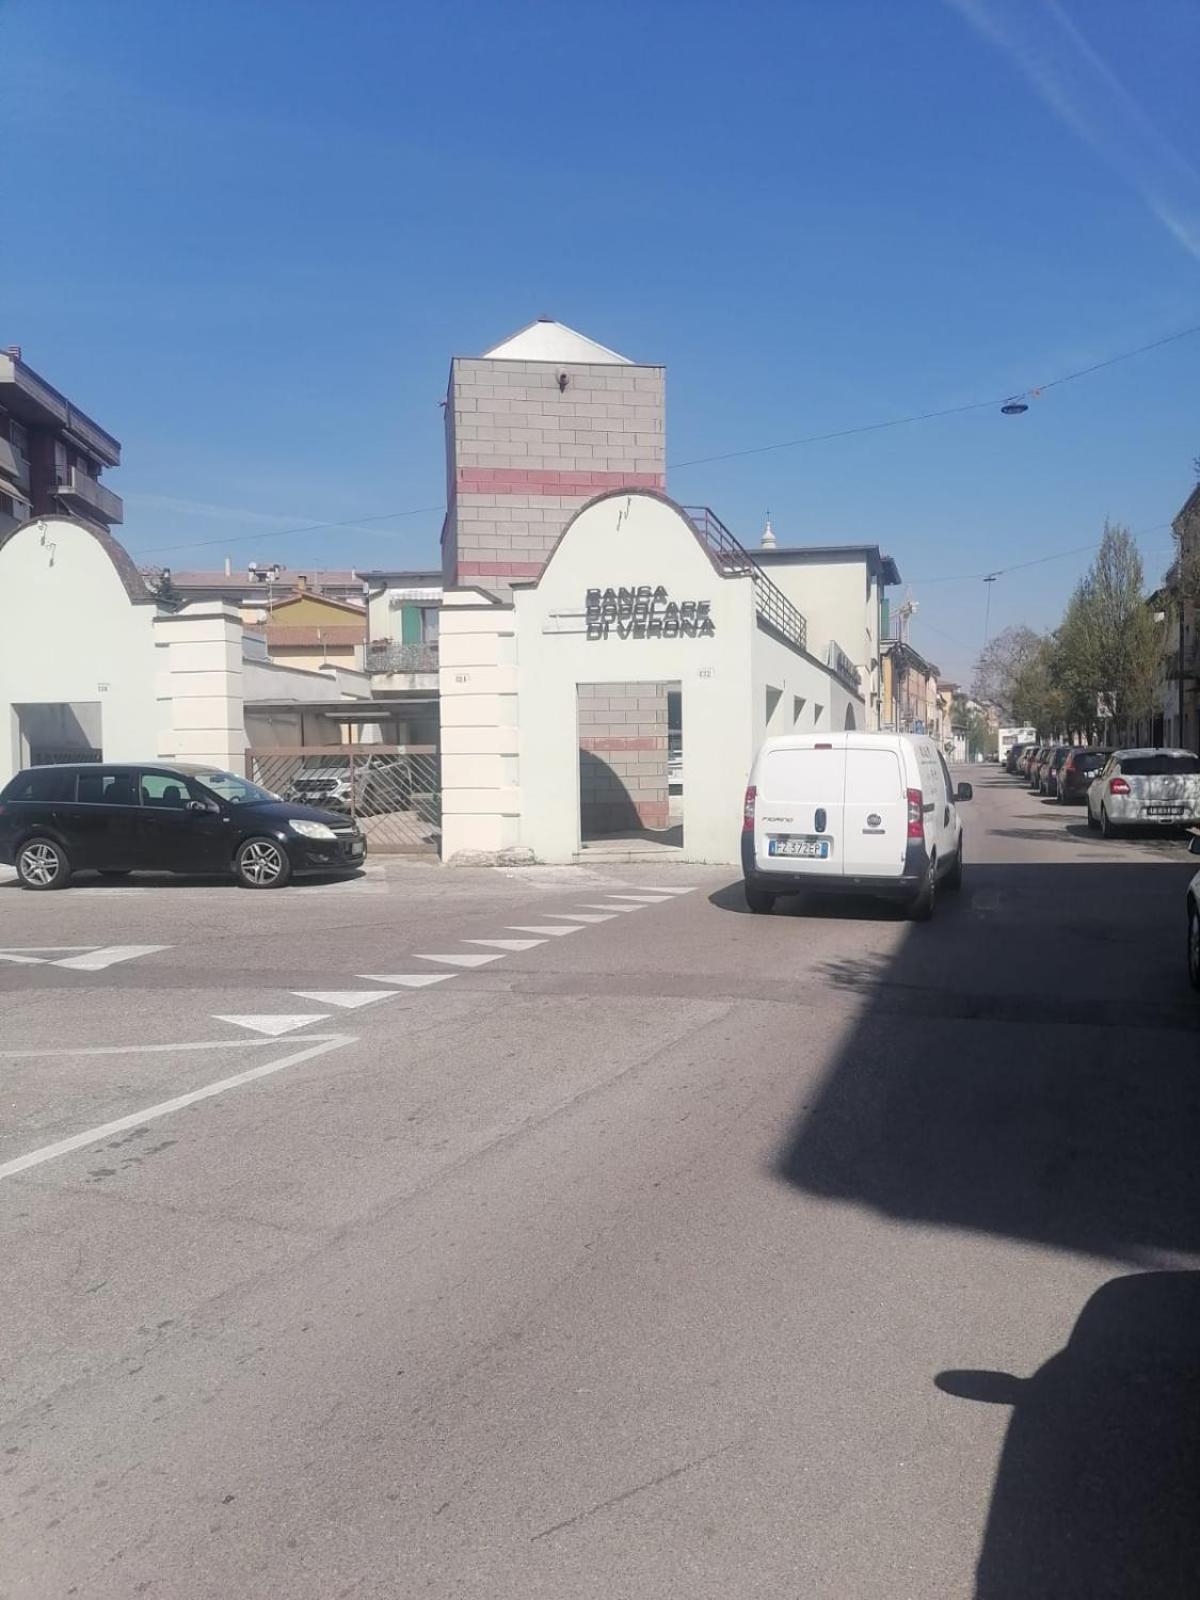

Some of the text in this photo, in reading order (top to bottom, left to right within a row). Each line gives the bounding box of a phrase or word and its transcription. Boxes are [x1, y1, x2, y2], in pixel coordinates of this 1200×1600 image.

[586, 585, 668, 602] BANCA
[586, 600, 711, 619] POPOLARE
[586, 618, 716, 638] DI VERONA
